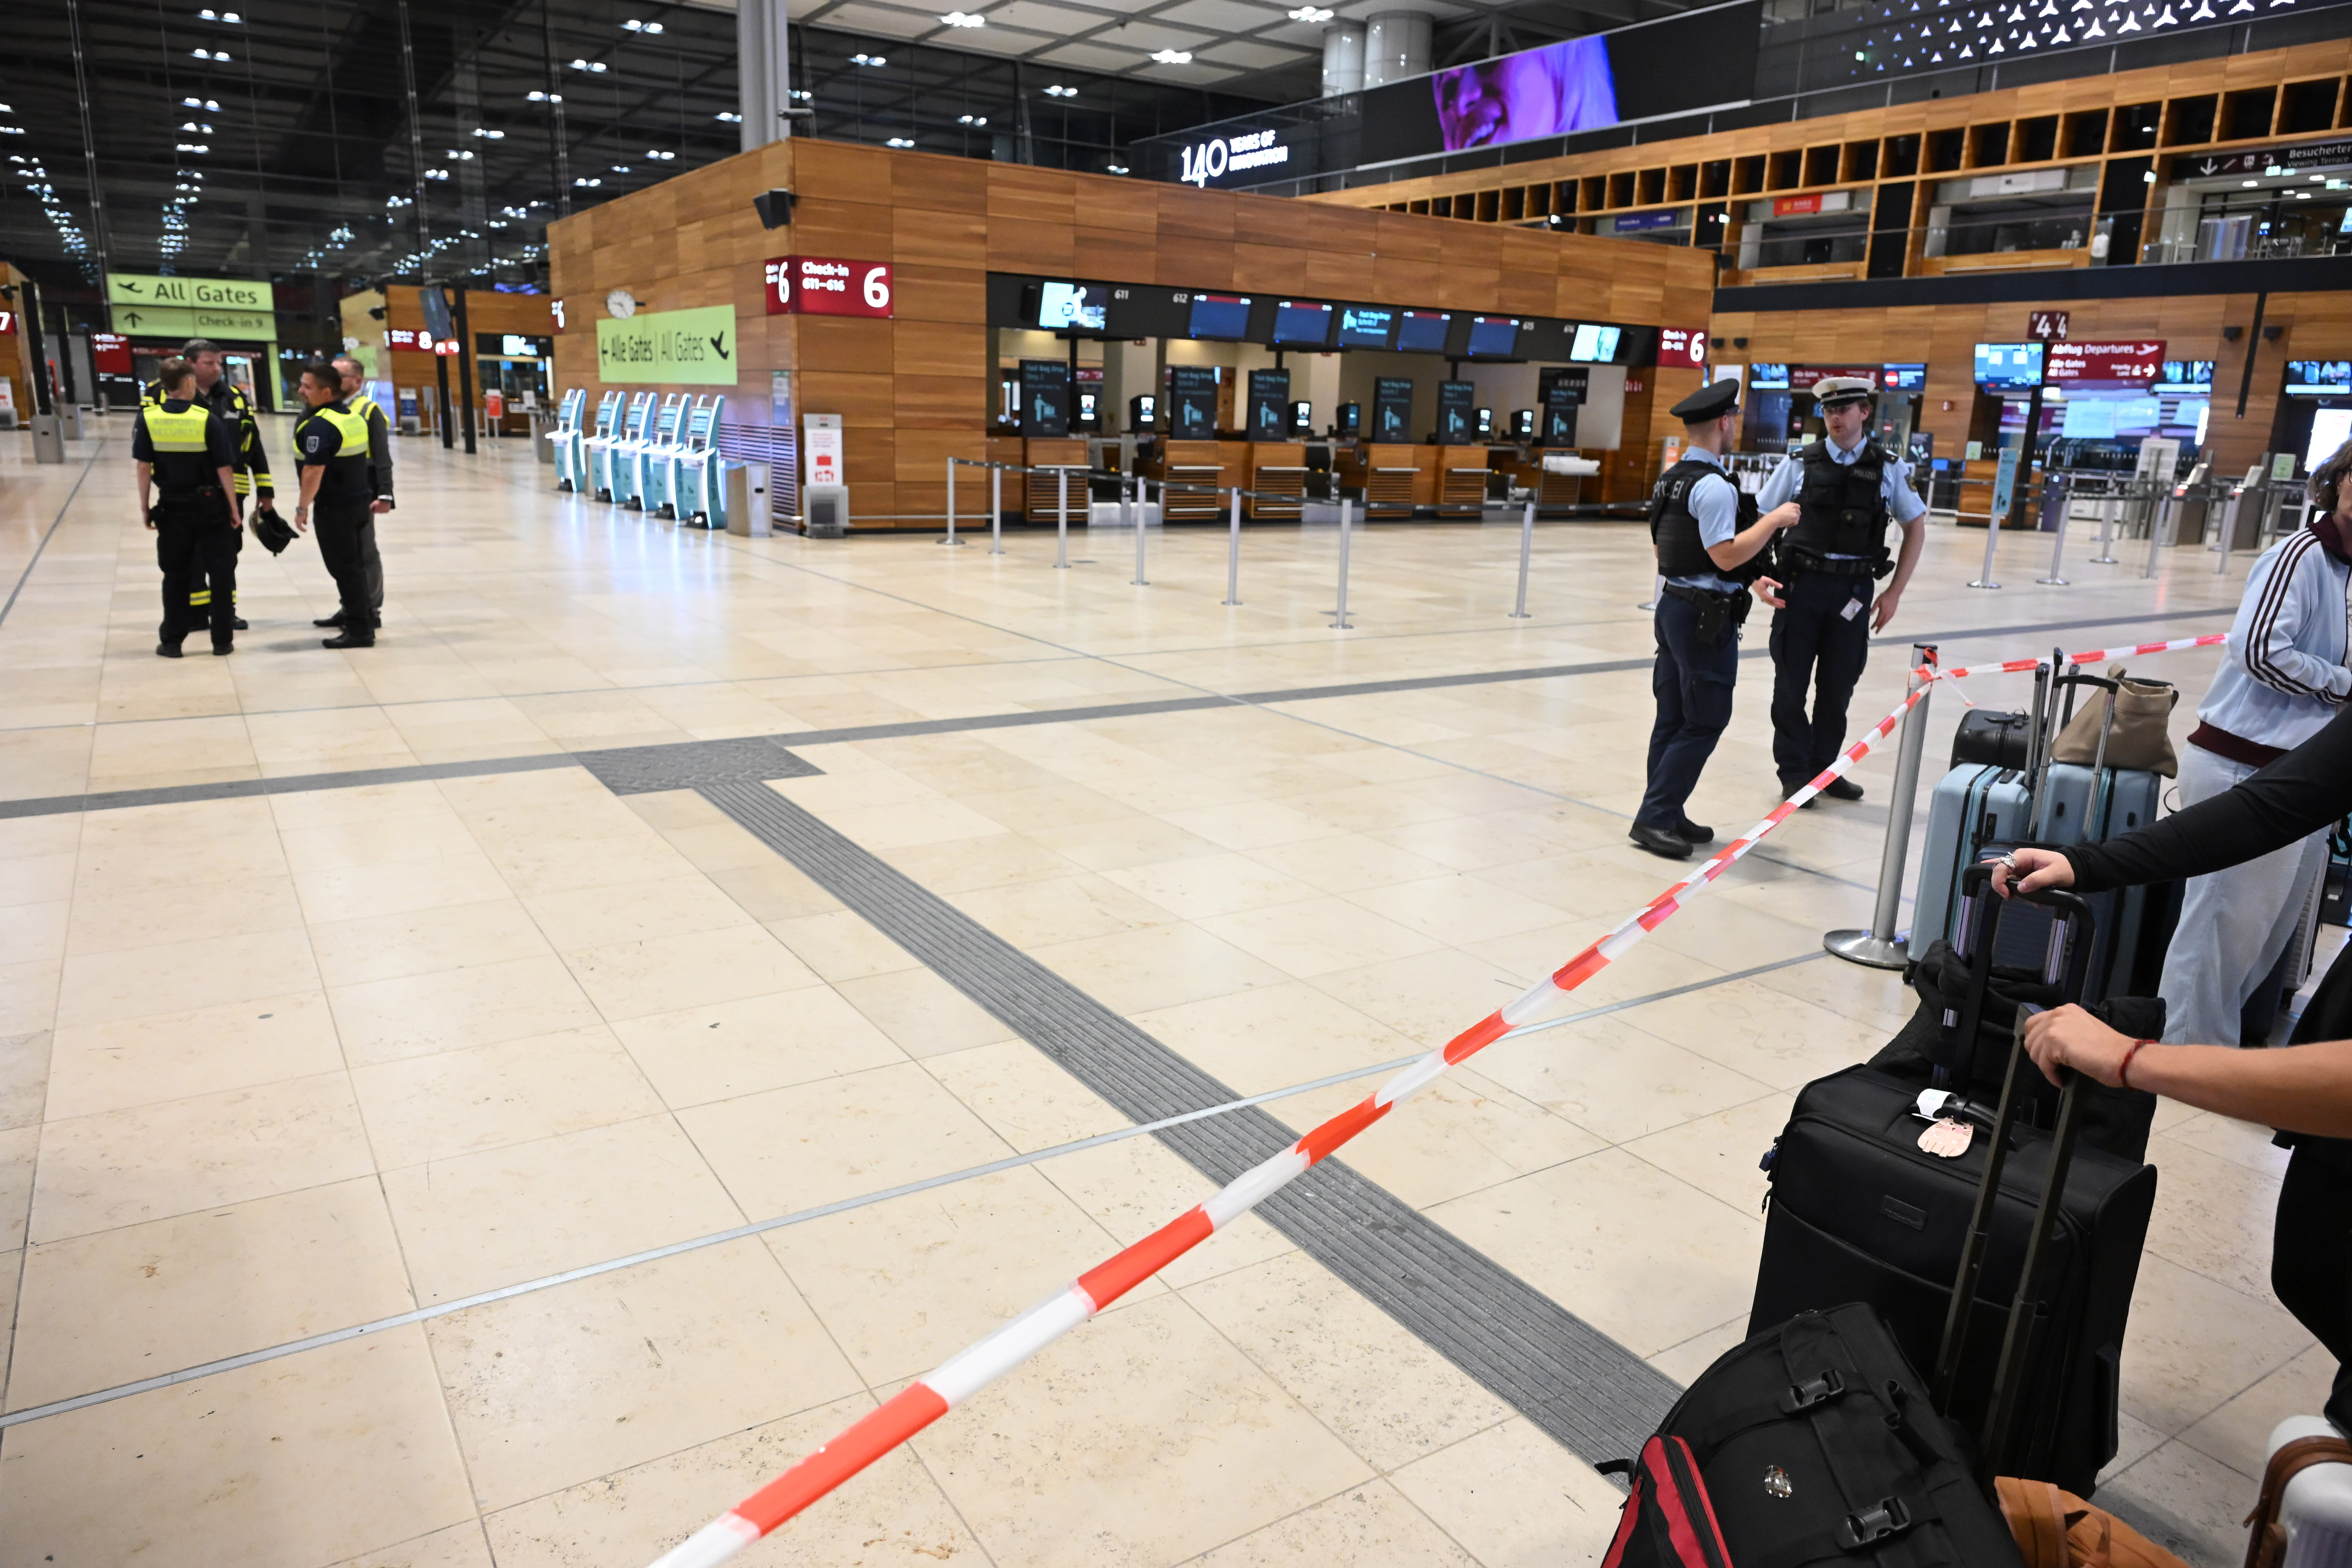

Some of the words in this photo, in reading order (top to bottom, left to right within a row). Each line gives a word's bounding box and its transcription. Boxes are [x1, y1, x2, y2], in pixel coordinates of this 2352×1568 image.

[1229, 133, 1260, 154] YEARS
[1260, 130, 1276, 148] OF
[1181, 139, 1228, 188] 140
[2287, 159, 2318, 168] Viewing
[2321, 156, 2349, 164] Terrace
[802, 262, 849, 277] Check-in
[779, 261, 790, 303] 6
[864, 267, 889, 308] 6
[155, 282, 185, 300] All
[197, 285, 257, 304] Gates
[1114, 289, 1129, 300] 611
[1172, 293, 1188, 304] 612
[2035, 314, 2052, 338] 4
[2057, 315, 2067, 339] 4
[419, 331, 432, 349] 8
[611, 334, 626, 362] Alle
[628, 334, 653, 362] Gates
[662, 330, 674, 362] All
[676, 332, 705, 362] Gates
[1690, 332, 1704, 362] 6
[2051, 344, 2083, 356] Abflug
[2084, 344, 2135, 356] Departures
[2059, 369, 2079, 377] Gates
[2065, 359, 2086, 368] Gates
[1854, 469, 1877, 480] POLIZEI
